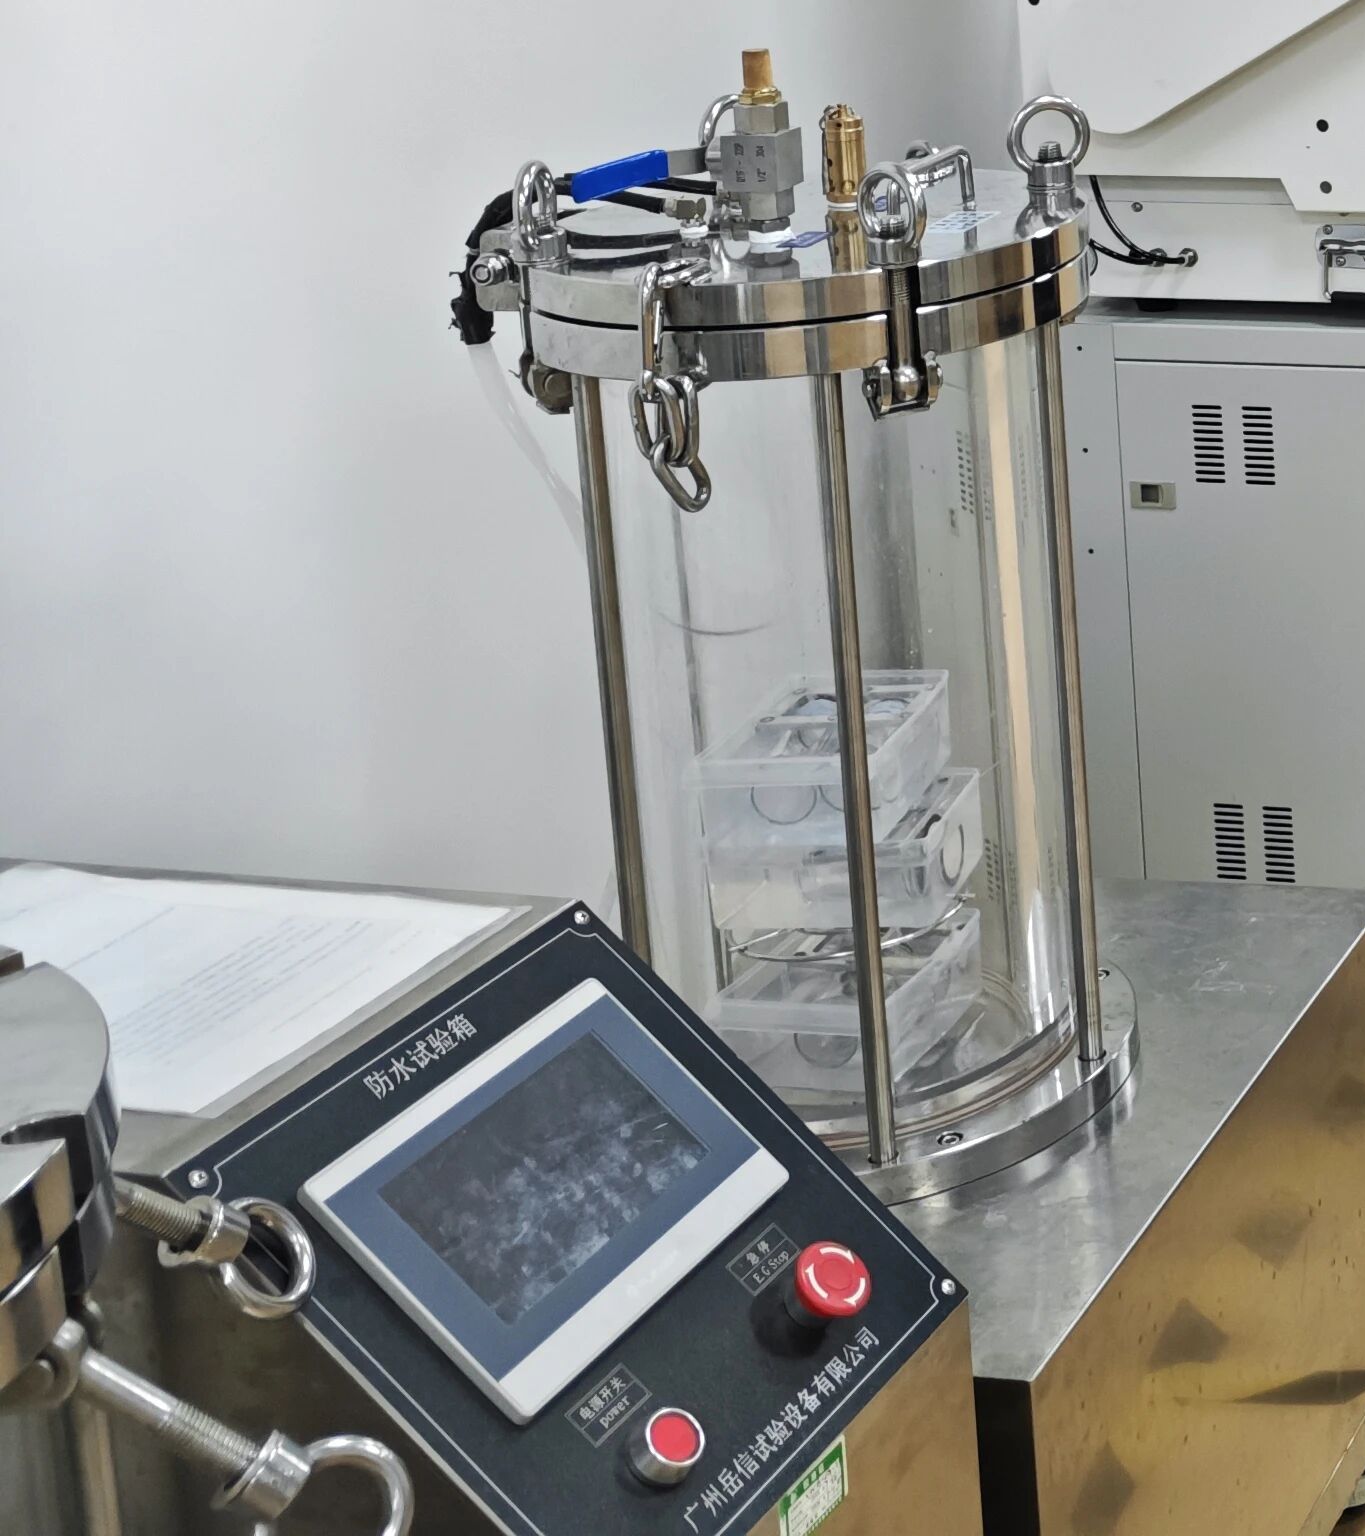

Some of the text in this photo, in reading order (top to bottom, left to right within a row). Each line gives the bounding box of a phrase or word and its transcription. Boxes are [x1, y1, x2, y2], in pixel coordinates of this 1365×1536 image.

[362, 1013, 478, 1100] 防水试验箱
[579, 1376, 627, 1421] 电源开关
[599, 1395, 631, 1430] power
[683, 1325, 880, 1534] 广州岳信试验设备有限公司
